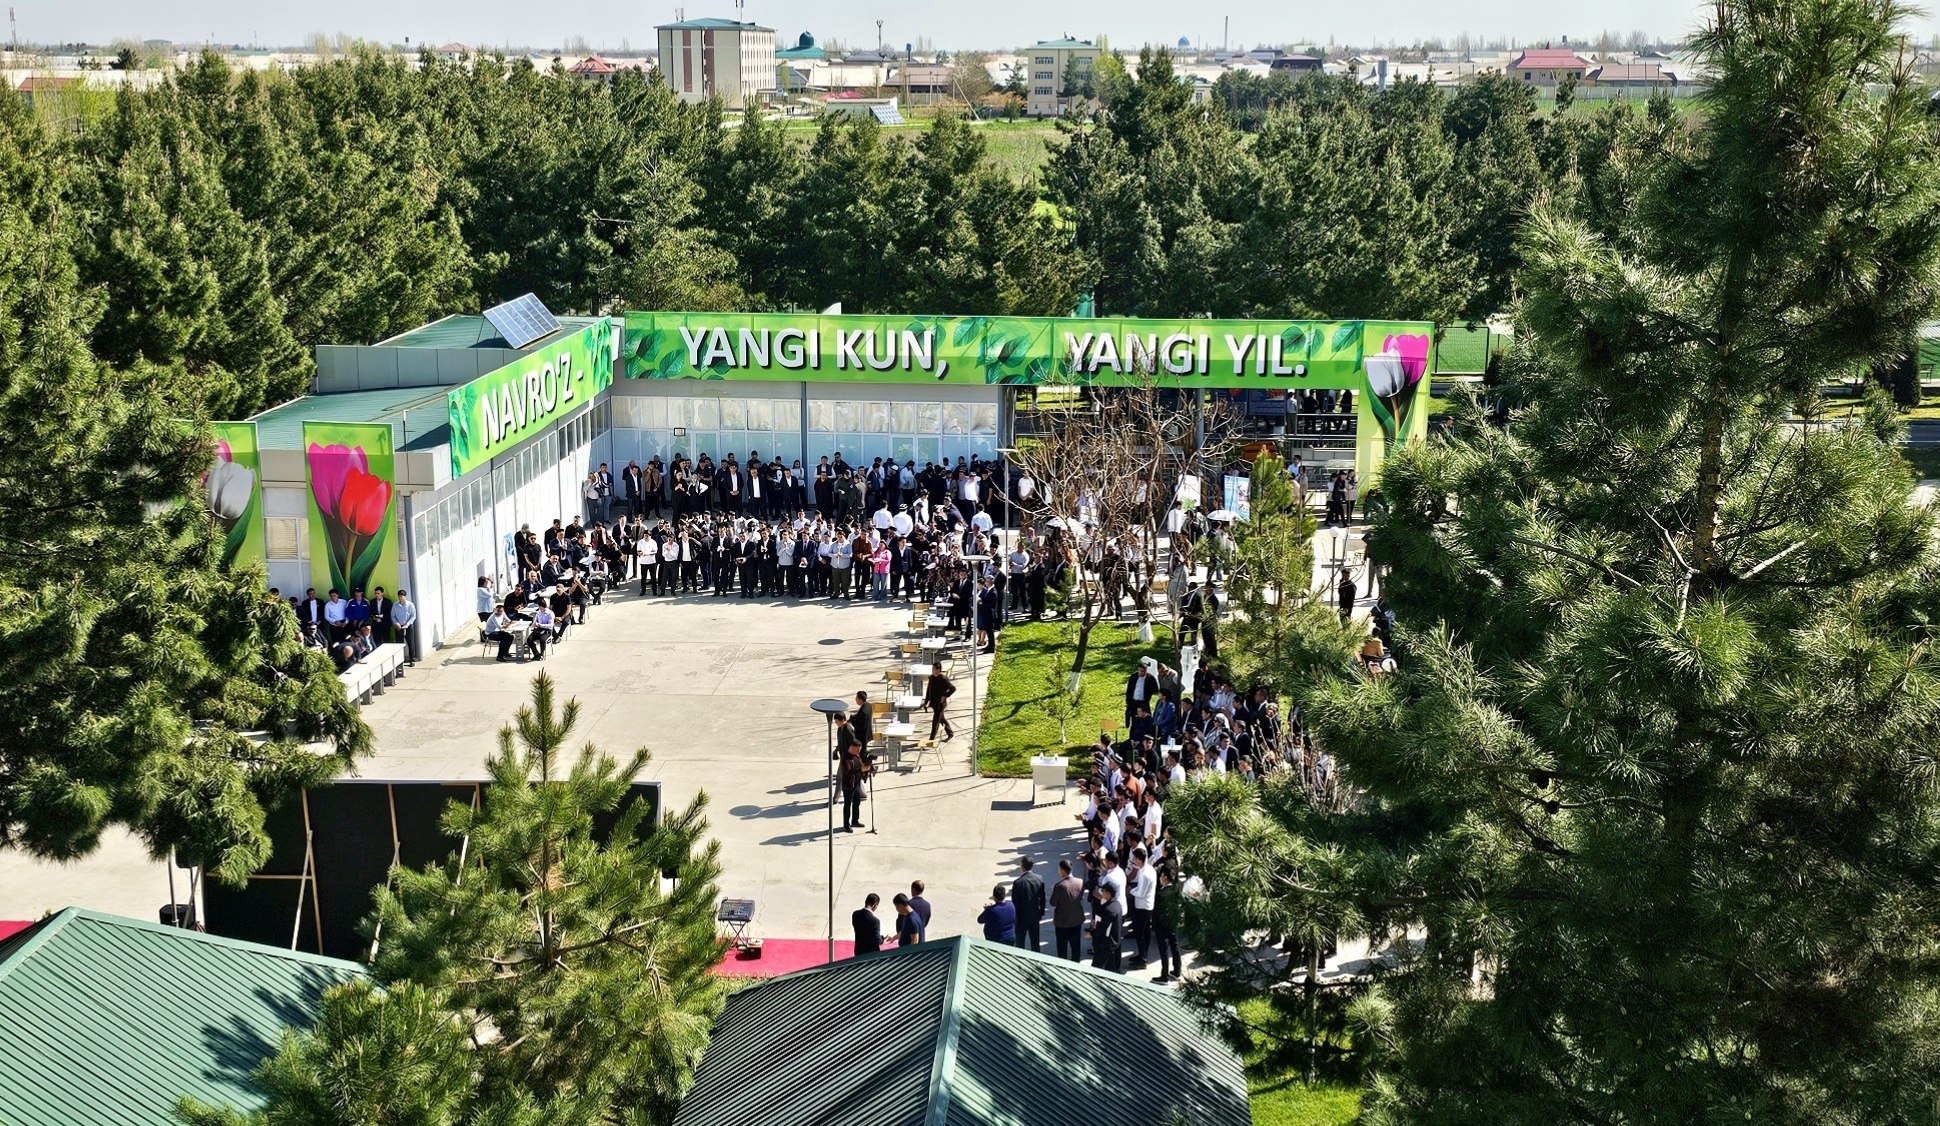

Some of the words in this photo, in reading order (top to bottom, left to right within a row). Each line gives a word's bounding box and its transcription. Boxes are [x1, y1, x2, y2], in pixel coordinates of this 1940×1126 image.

[679, 327, 819, 369] YANGI
[836, 329, 950, 379] KUN,
[1064, 332, 1210, 376] YANGI
[1224, 334, 1306, 376] YIL.
